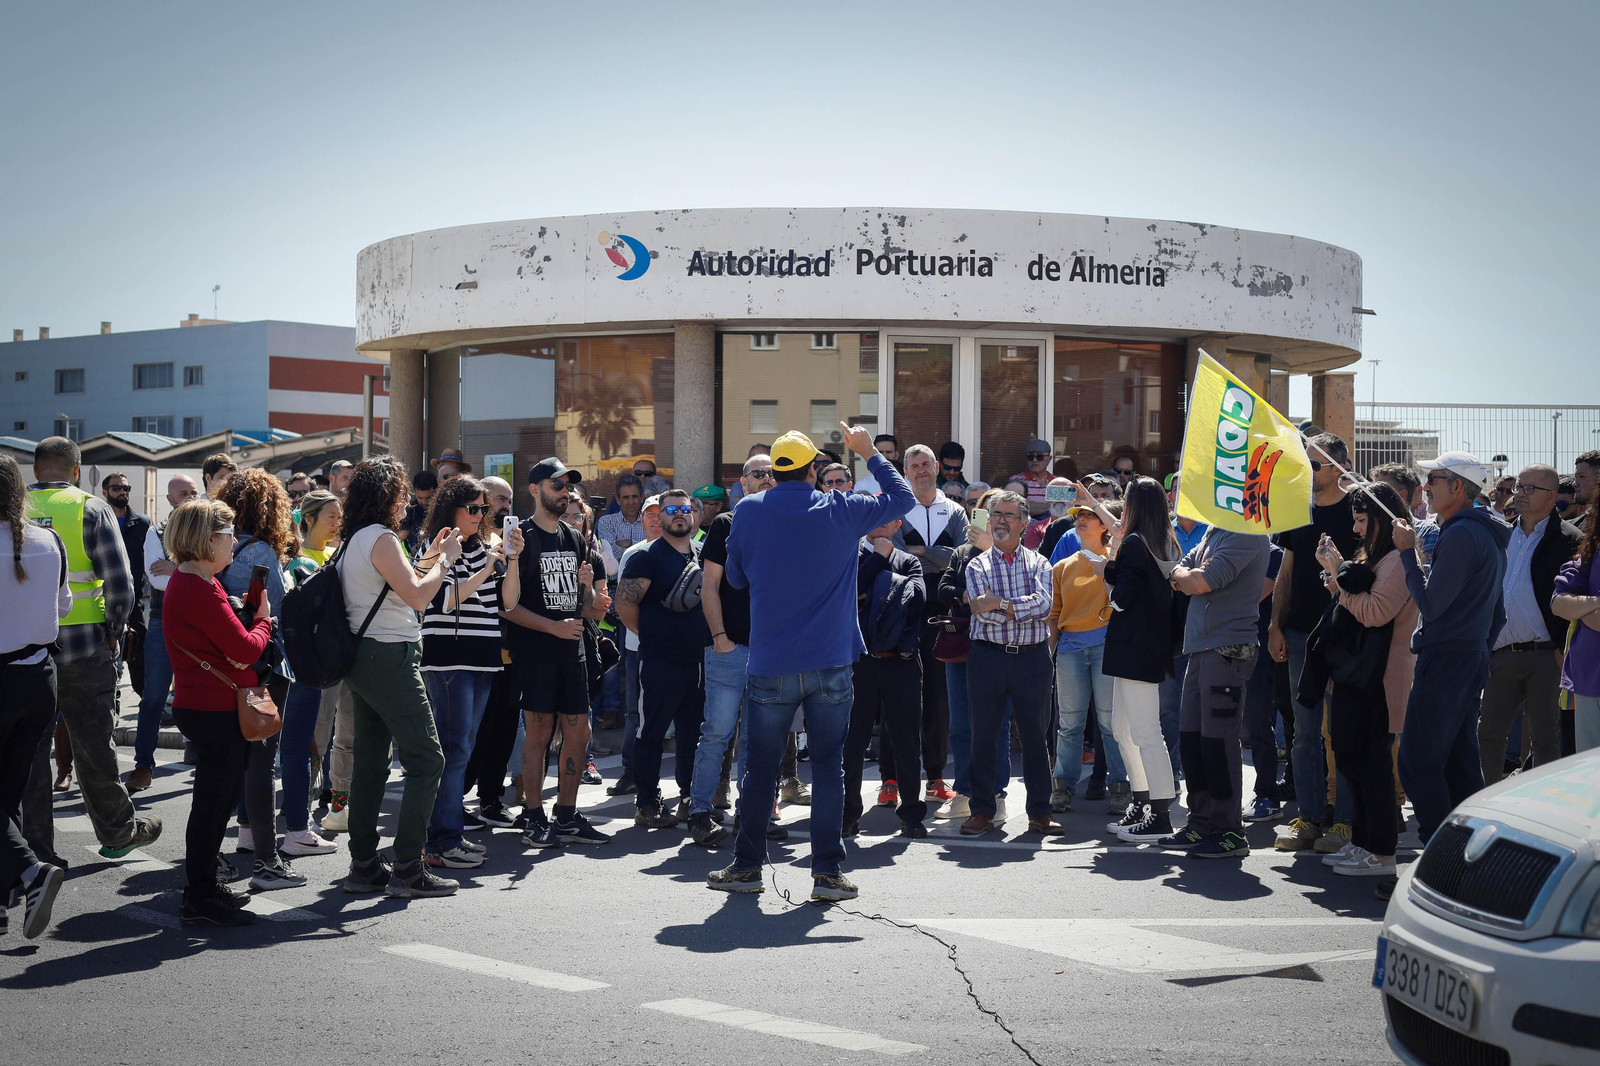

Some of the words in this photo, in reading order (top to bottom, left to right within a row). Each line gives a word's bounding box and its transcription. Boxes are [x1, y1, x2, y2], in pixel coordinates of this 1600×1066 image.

[687, 249, 831, 277] Autoridad
[856, 248, 994, 277] Portuaria
[1027, 253, 1061, 281] de
[1069, 255, 1166, 287] Almería
[541, 556, 578, 574] DOGFIGH
[550, 594, 578, 607] TOURNA
[1387, 948, 1430, 1004] 3381
[1435, 968, 1469, 1022] DZS
